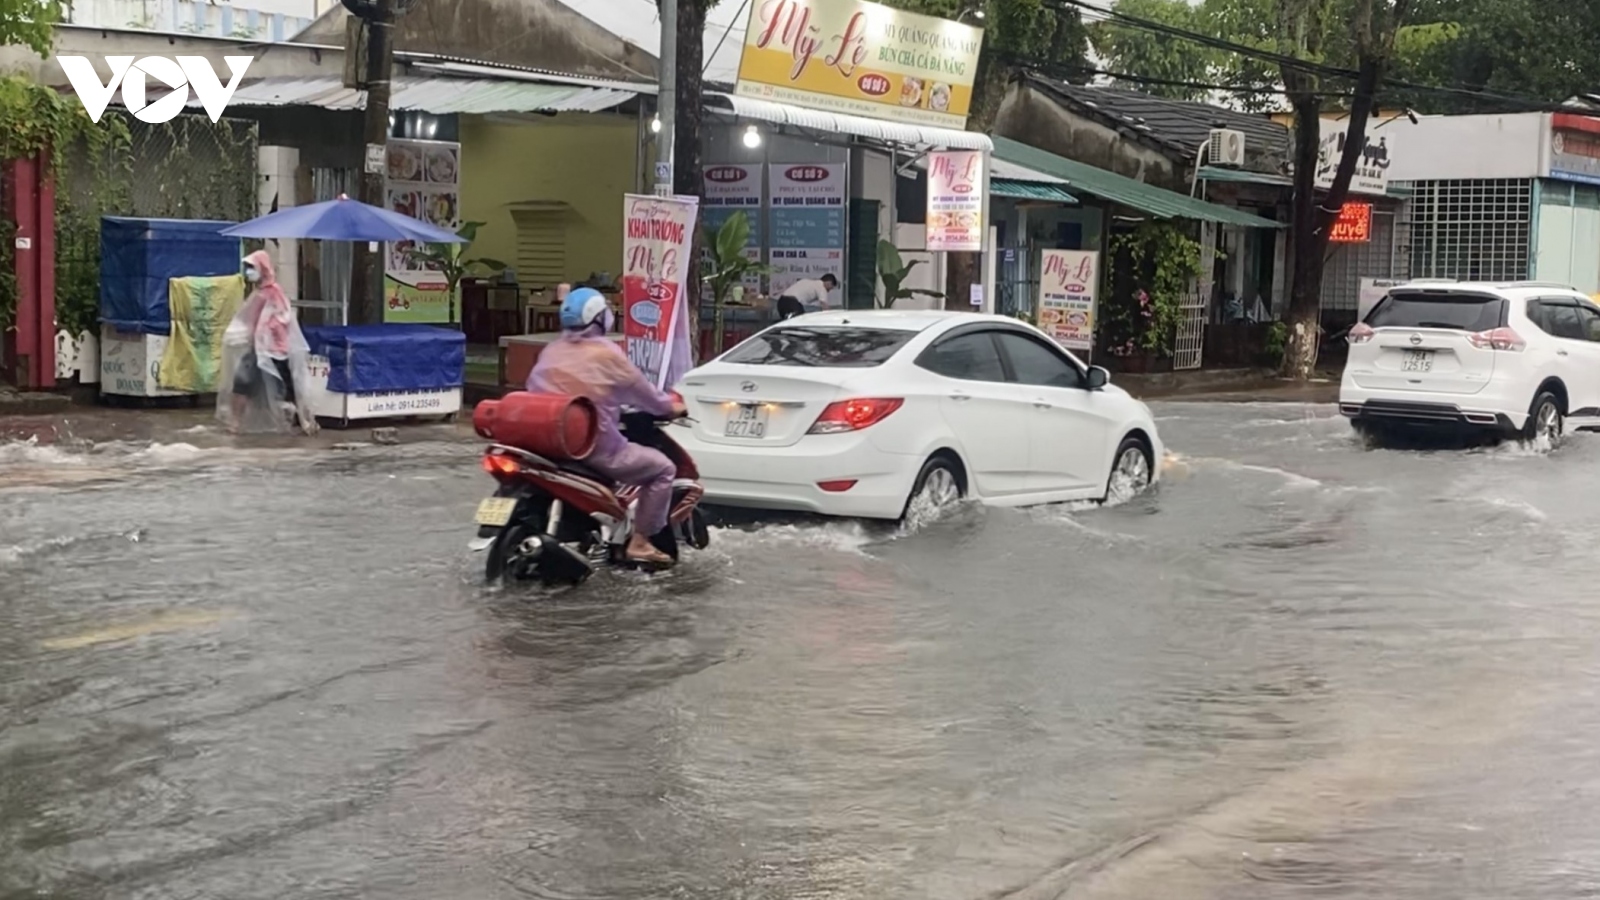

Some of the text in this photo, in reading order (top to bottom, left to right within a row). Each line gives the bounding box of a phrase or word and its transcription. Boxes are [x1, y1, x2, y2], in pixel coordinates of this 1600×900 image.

[757, 0, 823, 80] Mỹ
[878, 44, 898, 62] BÚN
[881, 81, 888, 92] 2
[816, 170, 823, 179] 2
[827, 197, 841, 205] NAM
[1043, 254, 1070, 286] Mỹ
